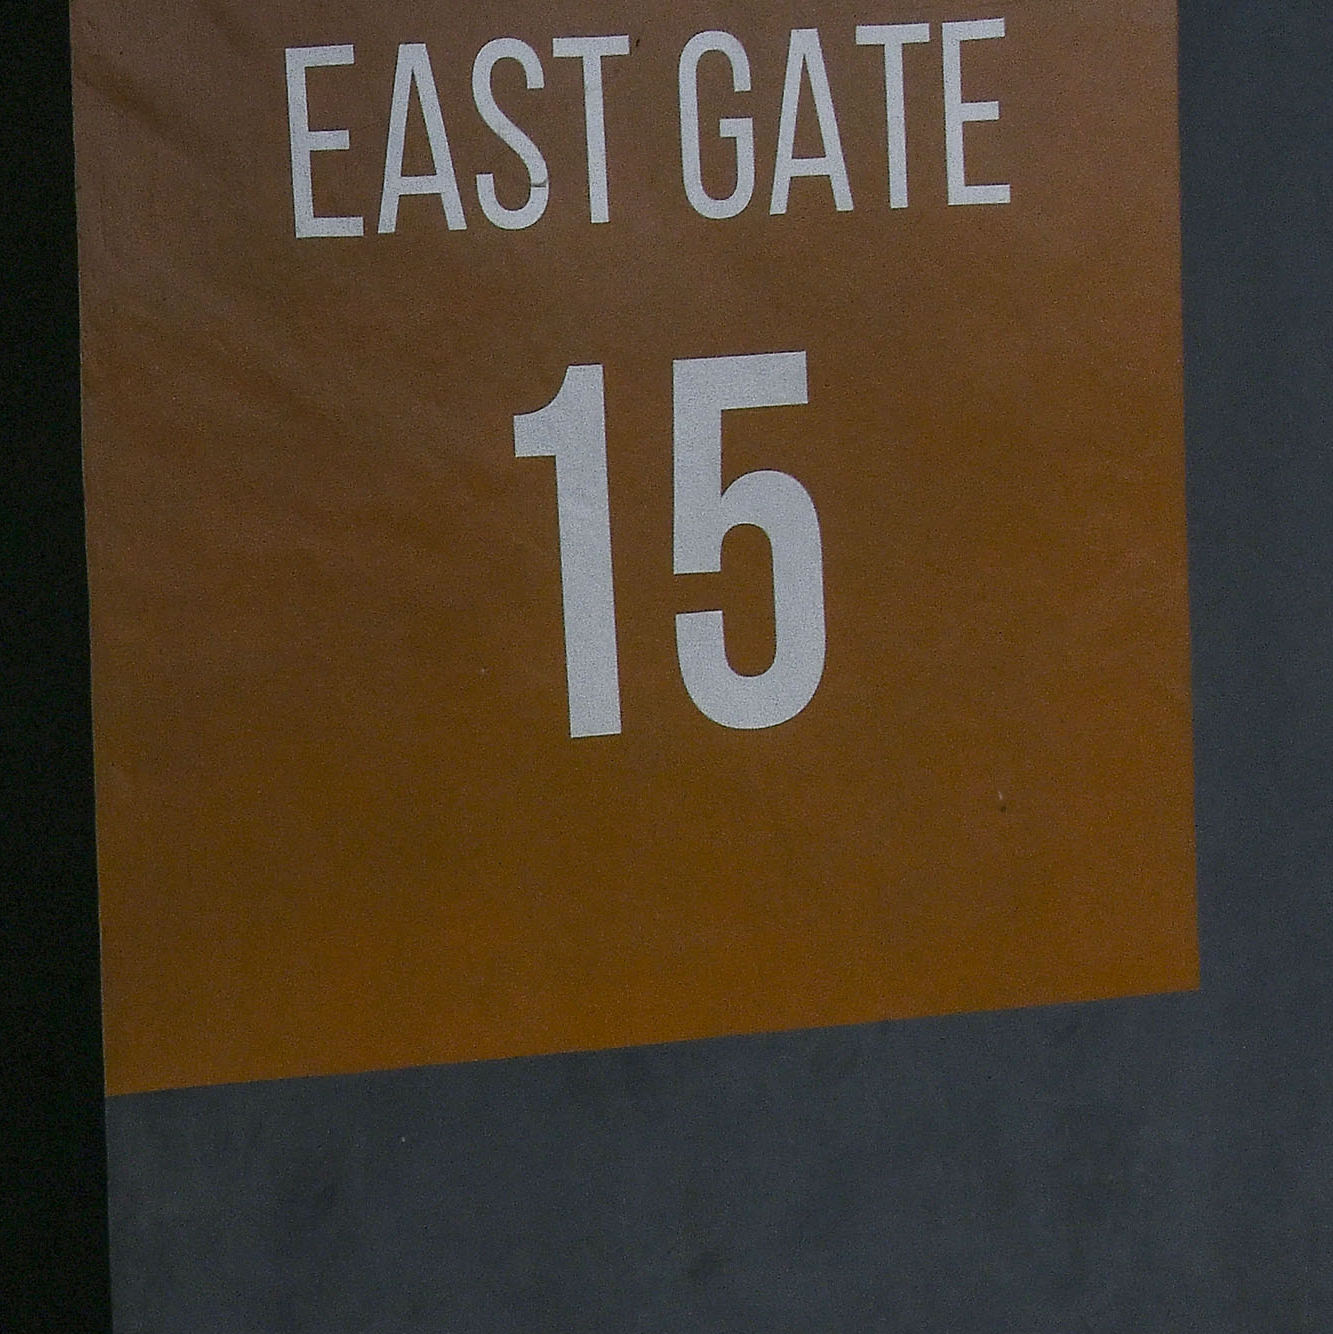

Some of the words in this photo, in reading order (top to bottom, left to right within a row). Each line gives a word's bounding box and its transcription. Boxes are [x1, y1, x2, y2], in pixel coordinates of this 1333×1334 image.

[284, 35, 631, 240] EAST
[676, 16, 1013, 222] GATE
[511, 349, 828, 739] 15
